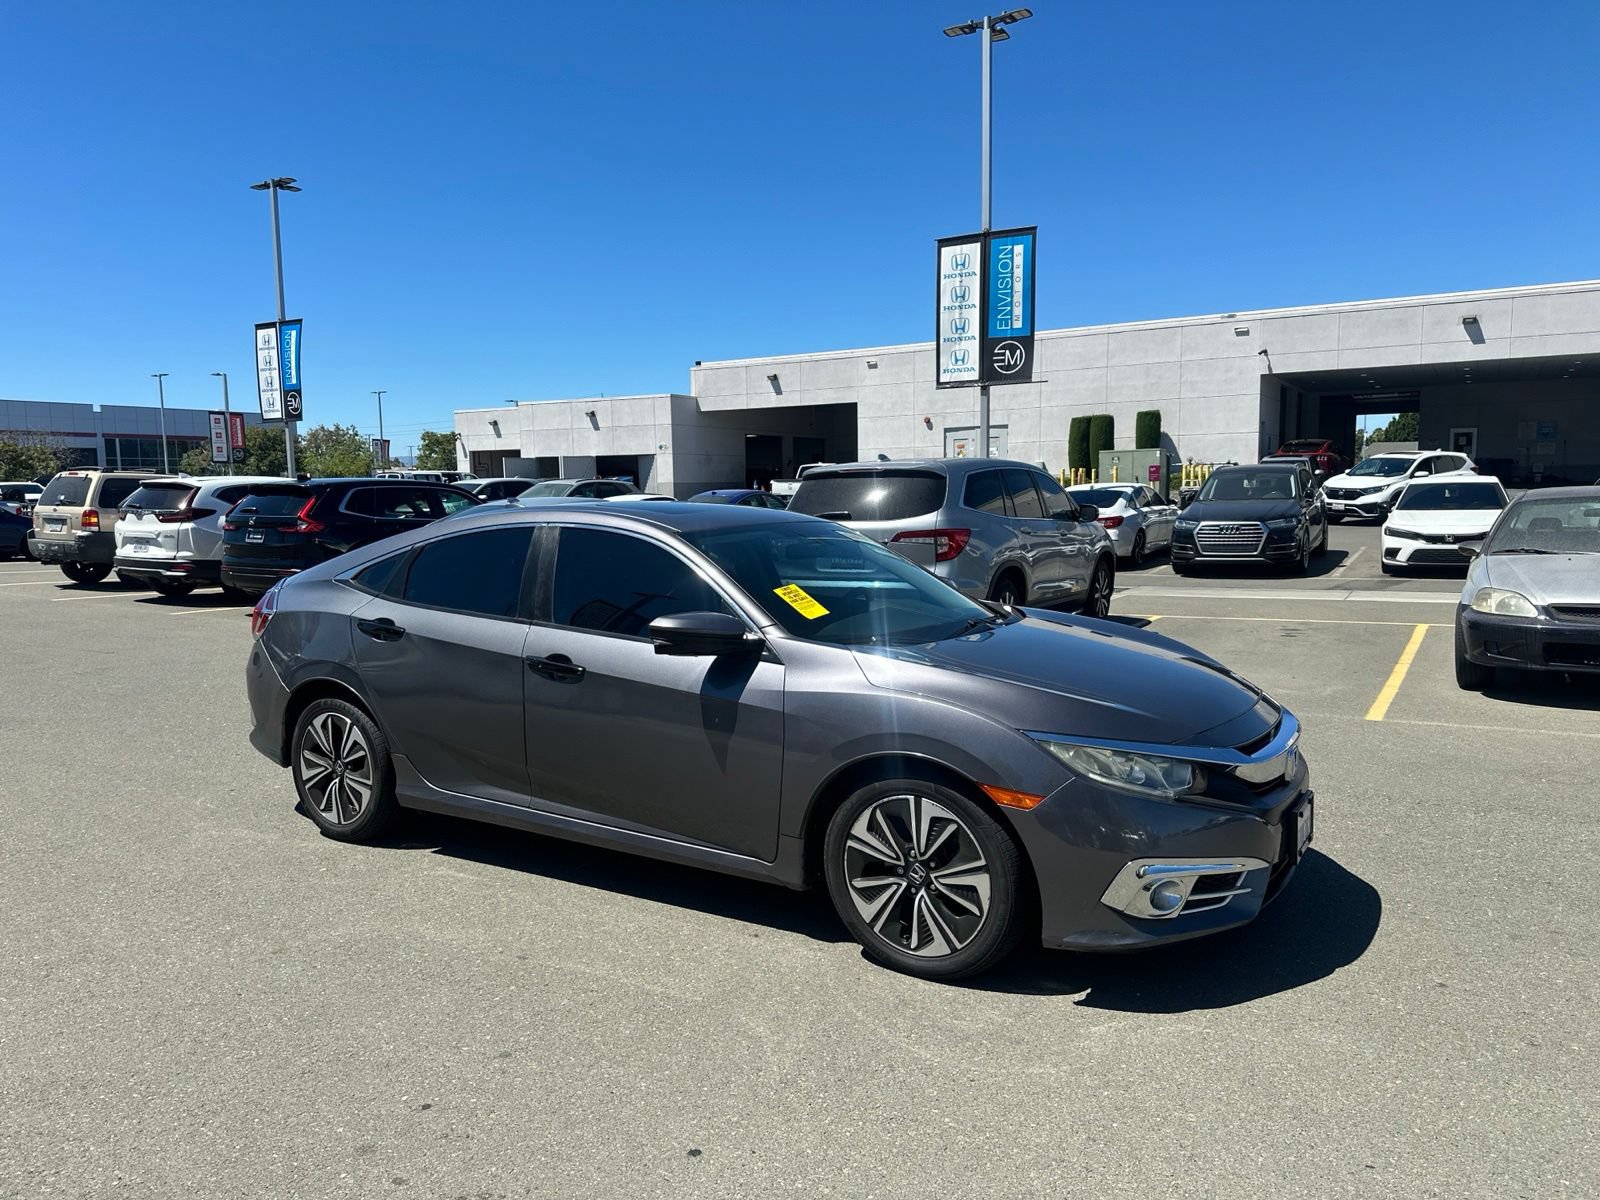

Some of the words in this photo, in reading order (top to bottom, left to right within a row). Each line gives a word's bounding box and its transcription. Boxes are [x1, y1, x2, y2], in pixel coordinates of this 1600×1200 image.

[943, 271, 978, 280] HONDA
[997, 245, 1013, 331] ENVISION
[1014, 251, 1022, 322] MOTORS
[943, 303, 977, 312] HONDA
[942, 335, 977, 343] HONDA
[942, 366, 977, 374] HONDA
